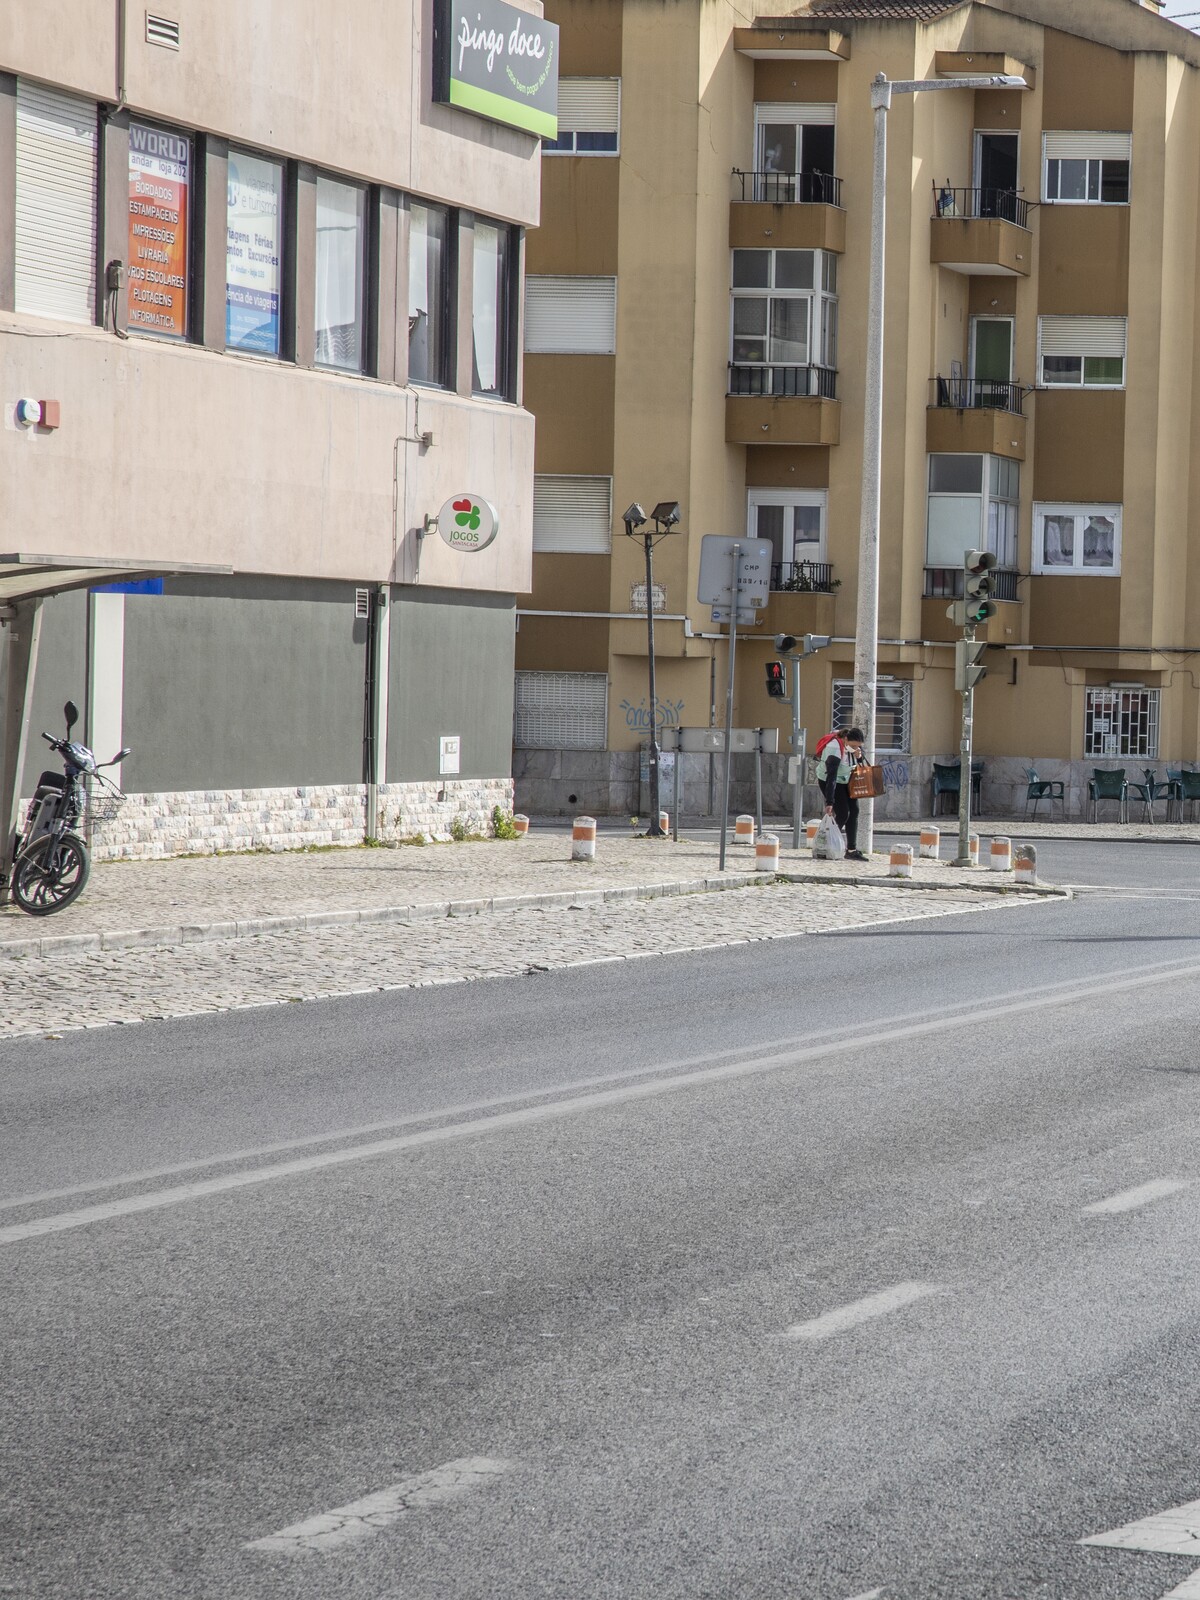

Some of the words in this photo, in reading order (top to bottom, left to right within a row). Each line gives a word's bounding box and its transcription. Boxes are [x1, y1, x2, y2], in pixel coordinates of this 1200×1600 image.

[457, 12, 504, 73] pingo
[508, 17, 545, 59] doce
[129, 127, 187, 162] WORLD
[131, 154, 152, 168] andar
[158, 159, 172, 175] loja
[173, 164, 187, 178] 202
[135, 181, 173, 201] BORDADOS
[129, 200, 179, 224] ESTAMPAGENS
[132, 223, 175, 244] IMPRESSÕES
[254, 232, 273, 249] Férias
[137, 246, 168, 264] LIVRARIA
[247, 247, 279, 266] Excursões
[146, 269, 184, 289] ESCOLARES
[133, 287, 173, 308] PLOTAGENS
[245, 291, 253, 306] de
[254, 294, 277, 311] viagens
[130, 308, 175, 329] INFORMÁTICA
[449, 530, 479, 543] JOGOS
[744, 564, 760, 572] CMP
